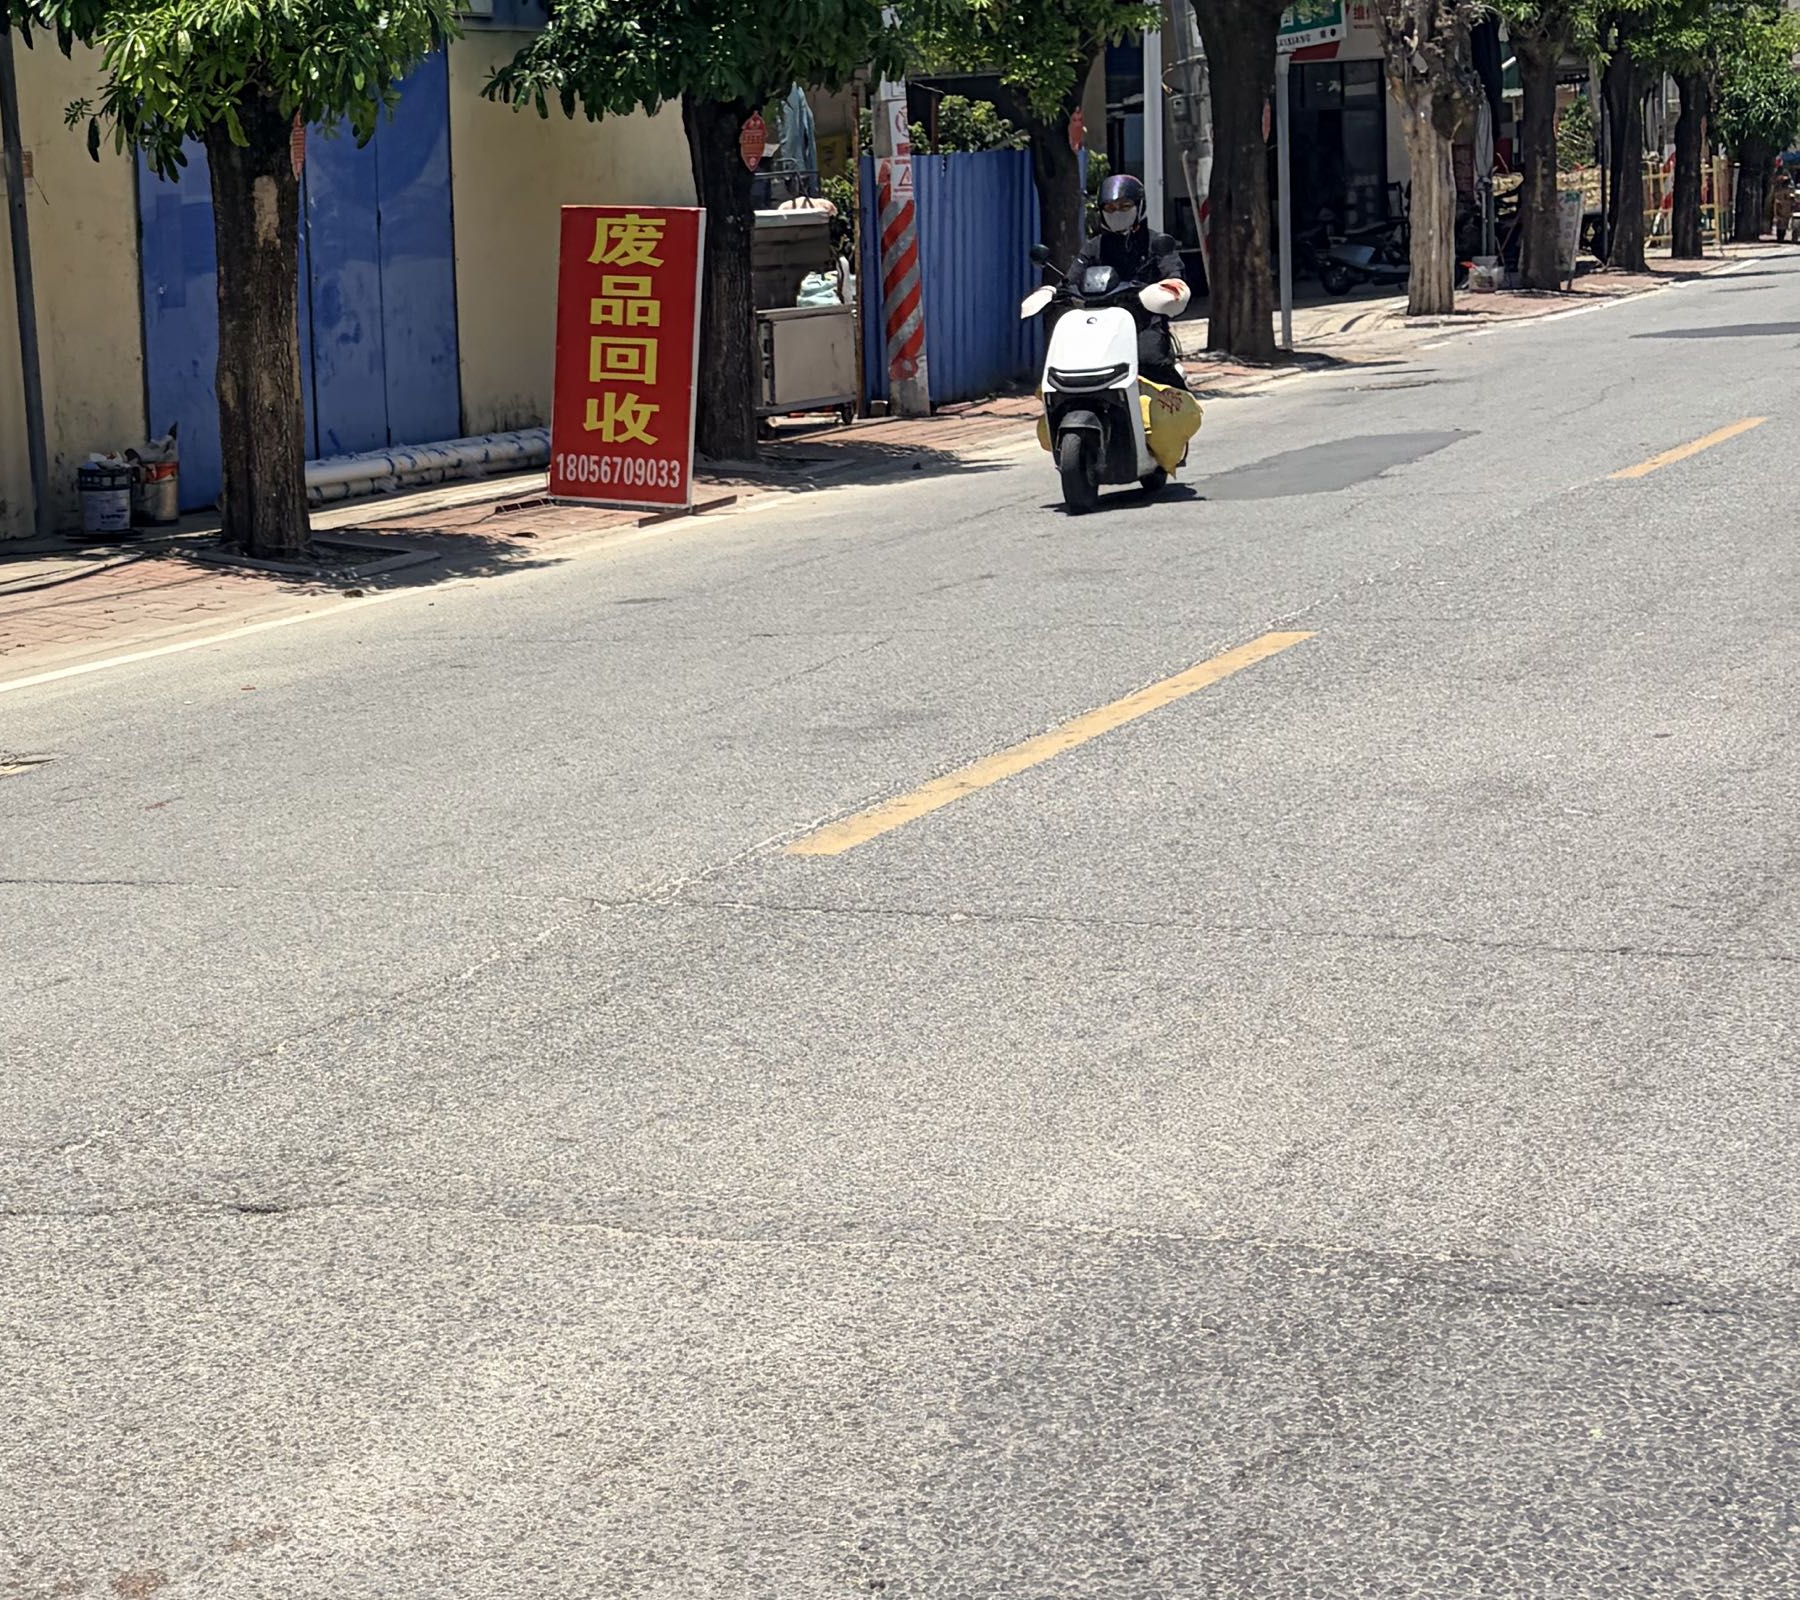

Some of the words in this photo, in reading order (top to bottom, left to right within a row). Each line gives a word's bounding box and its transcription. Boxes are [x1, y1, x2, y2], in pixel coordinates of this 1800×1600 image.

[583, 213, 667, 447] 废品回收
[556, 453, 682, 489] 18056709033
